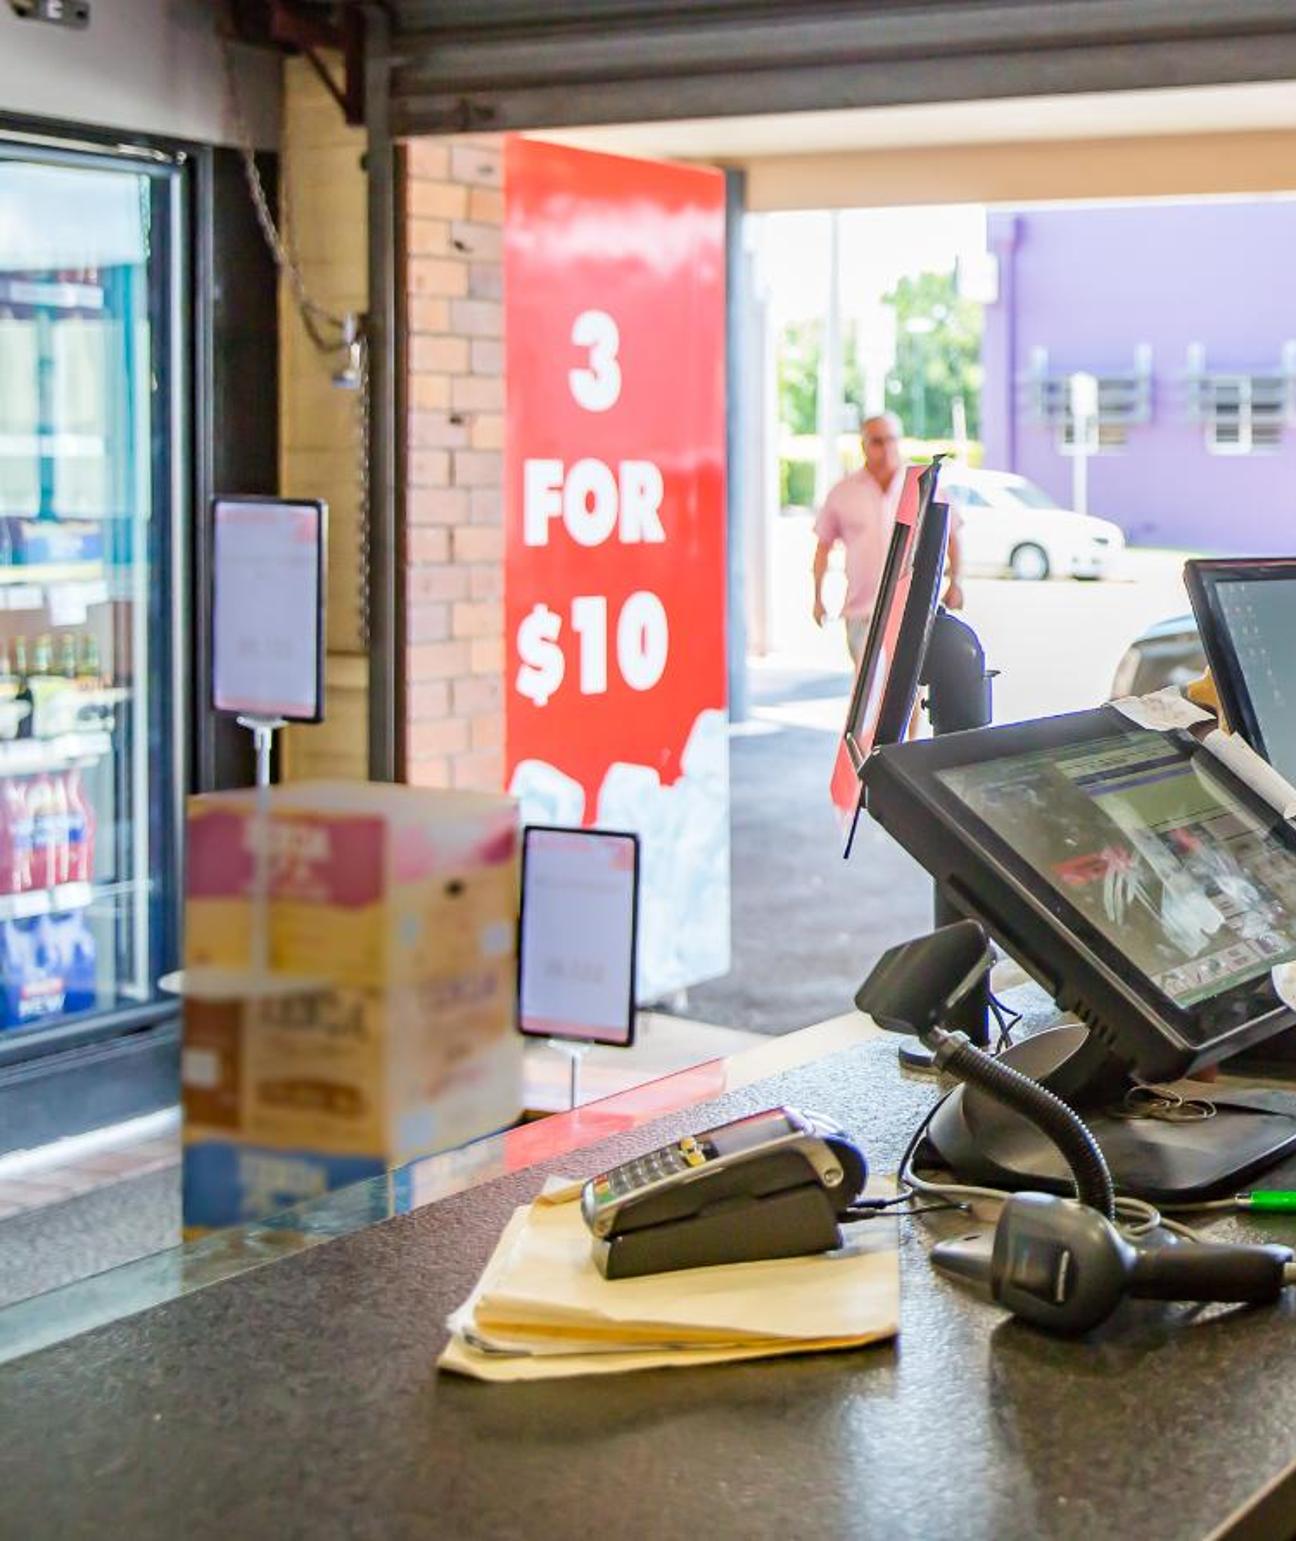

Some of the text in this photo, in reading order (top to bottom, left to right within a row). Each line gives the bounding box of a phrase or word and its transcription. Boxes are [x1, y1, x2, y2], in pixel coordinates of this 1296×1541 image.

[569, 309, 621, 412] 3
[523, 457, 666, 547] FOR
[515, 590, 669, 706] $10
